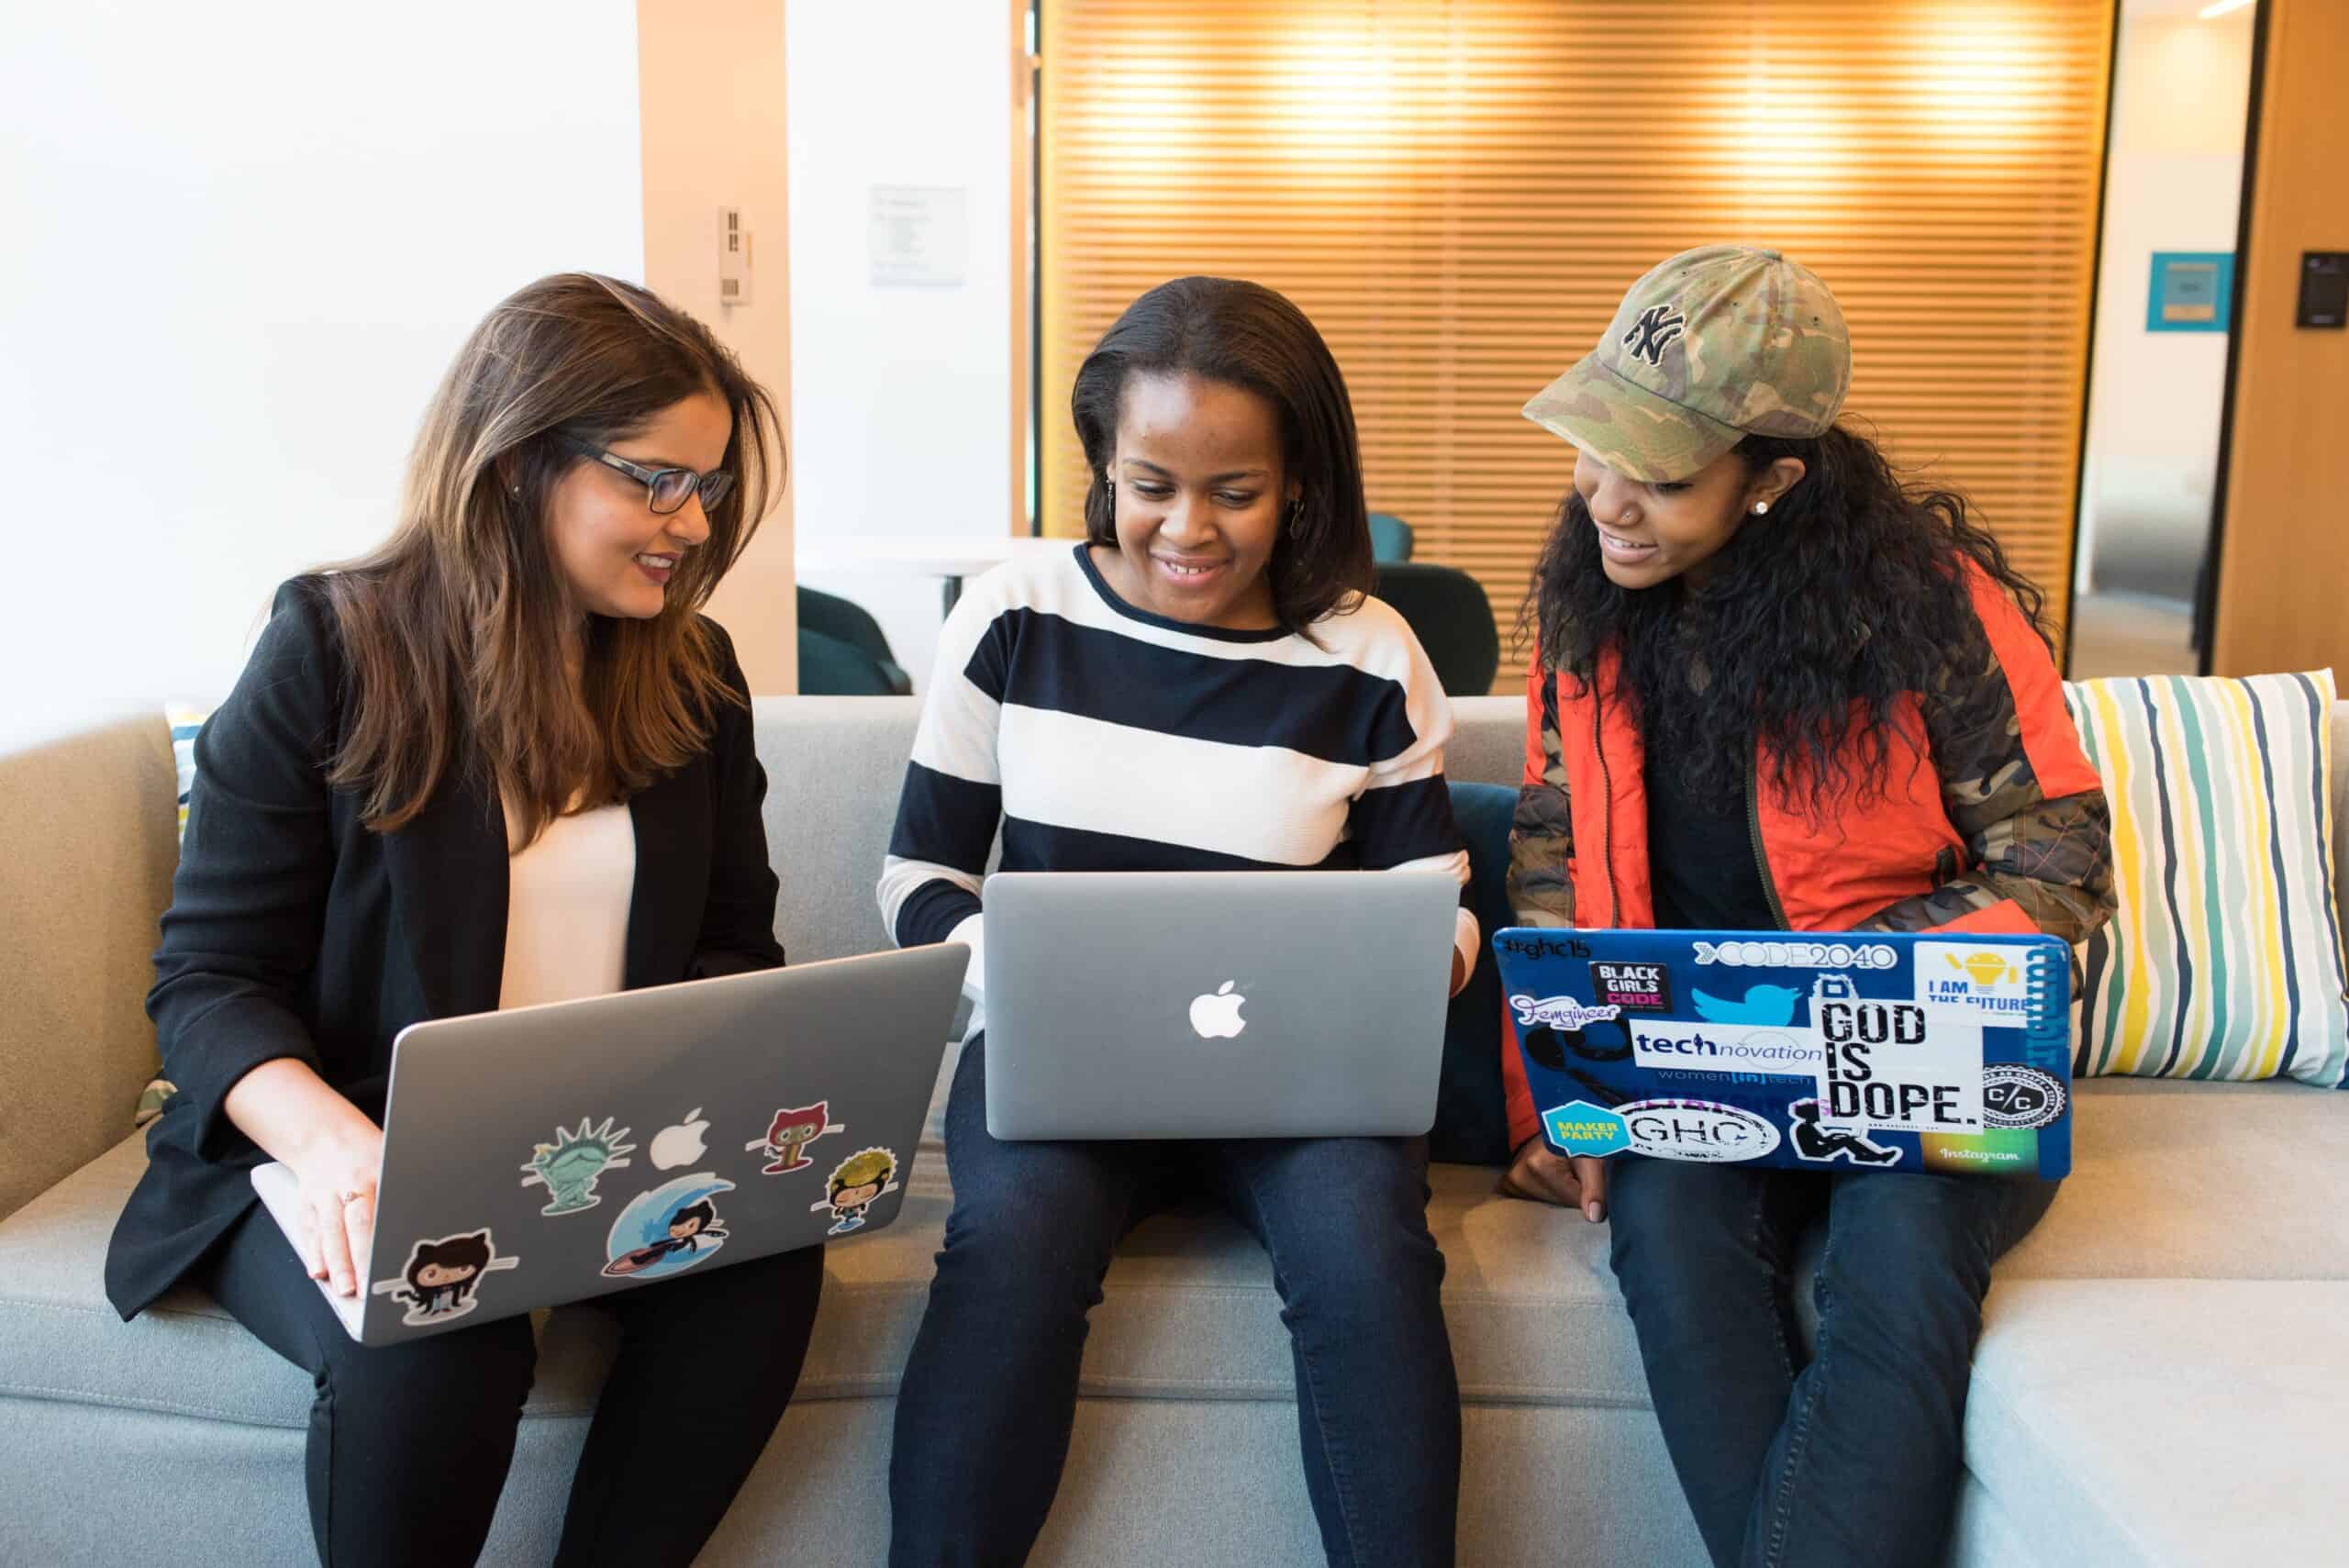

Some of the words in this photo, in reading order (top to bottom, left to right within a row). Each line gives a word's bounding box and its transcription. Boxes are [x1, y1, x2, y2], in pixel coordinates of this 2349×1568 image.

[1621, 305, 1686, 366] NY
[1599, 965, 1660, 981] BLACK
[1607, 979, 1659, 993] GIRLS
[1929, 980, 1934, 992] I
[1940, 981, 1968, 994] AM
[1607, 993, 1664, 1006] CODE
[1513, 997, 1619, 1029] Femgineer
[1821, 1003, 1926, 1044] GOD
[1636, 1033, 1822, 1062] technovation
[1825, 1041, 1873, 1082] IS
[1829, 1081, 1977, 1125] DOPE.
[1557, 1122, 1619, 1131] MAKER
[1561, 1130, 1614, 1140] PARTY
[1631, 1117, 1746, 1144] GHC
[1940, 1147, 2021, 1163] Instagram
